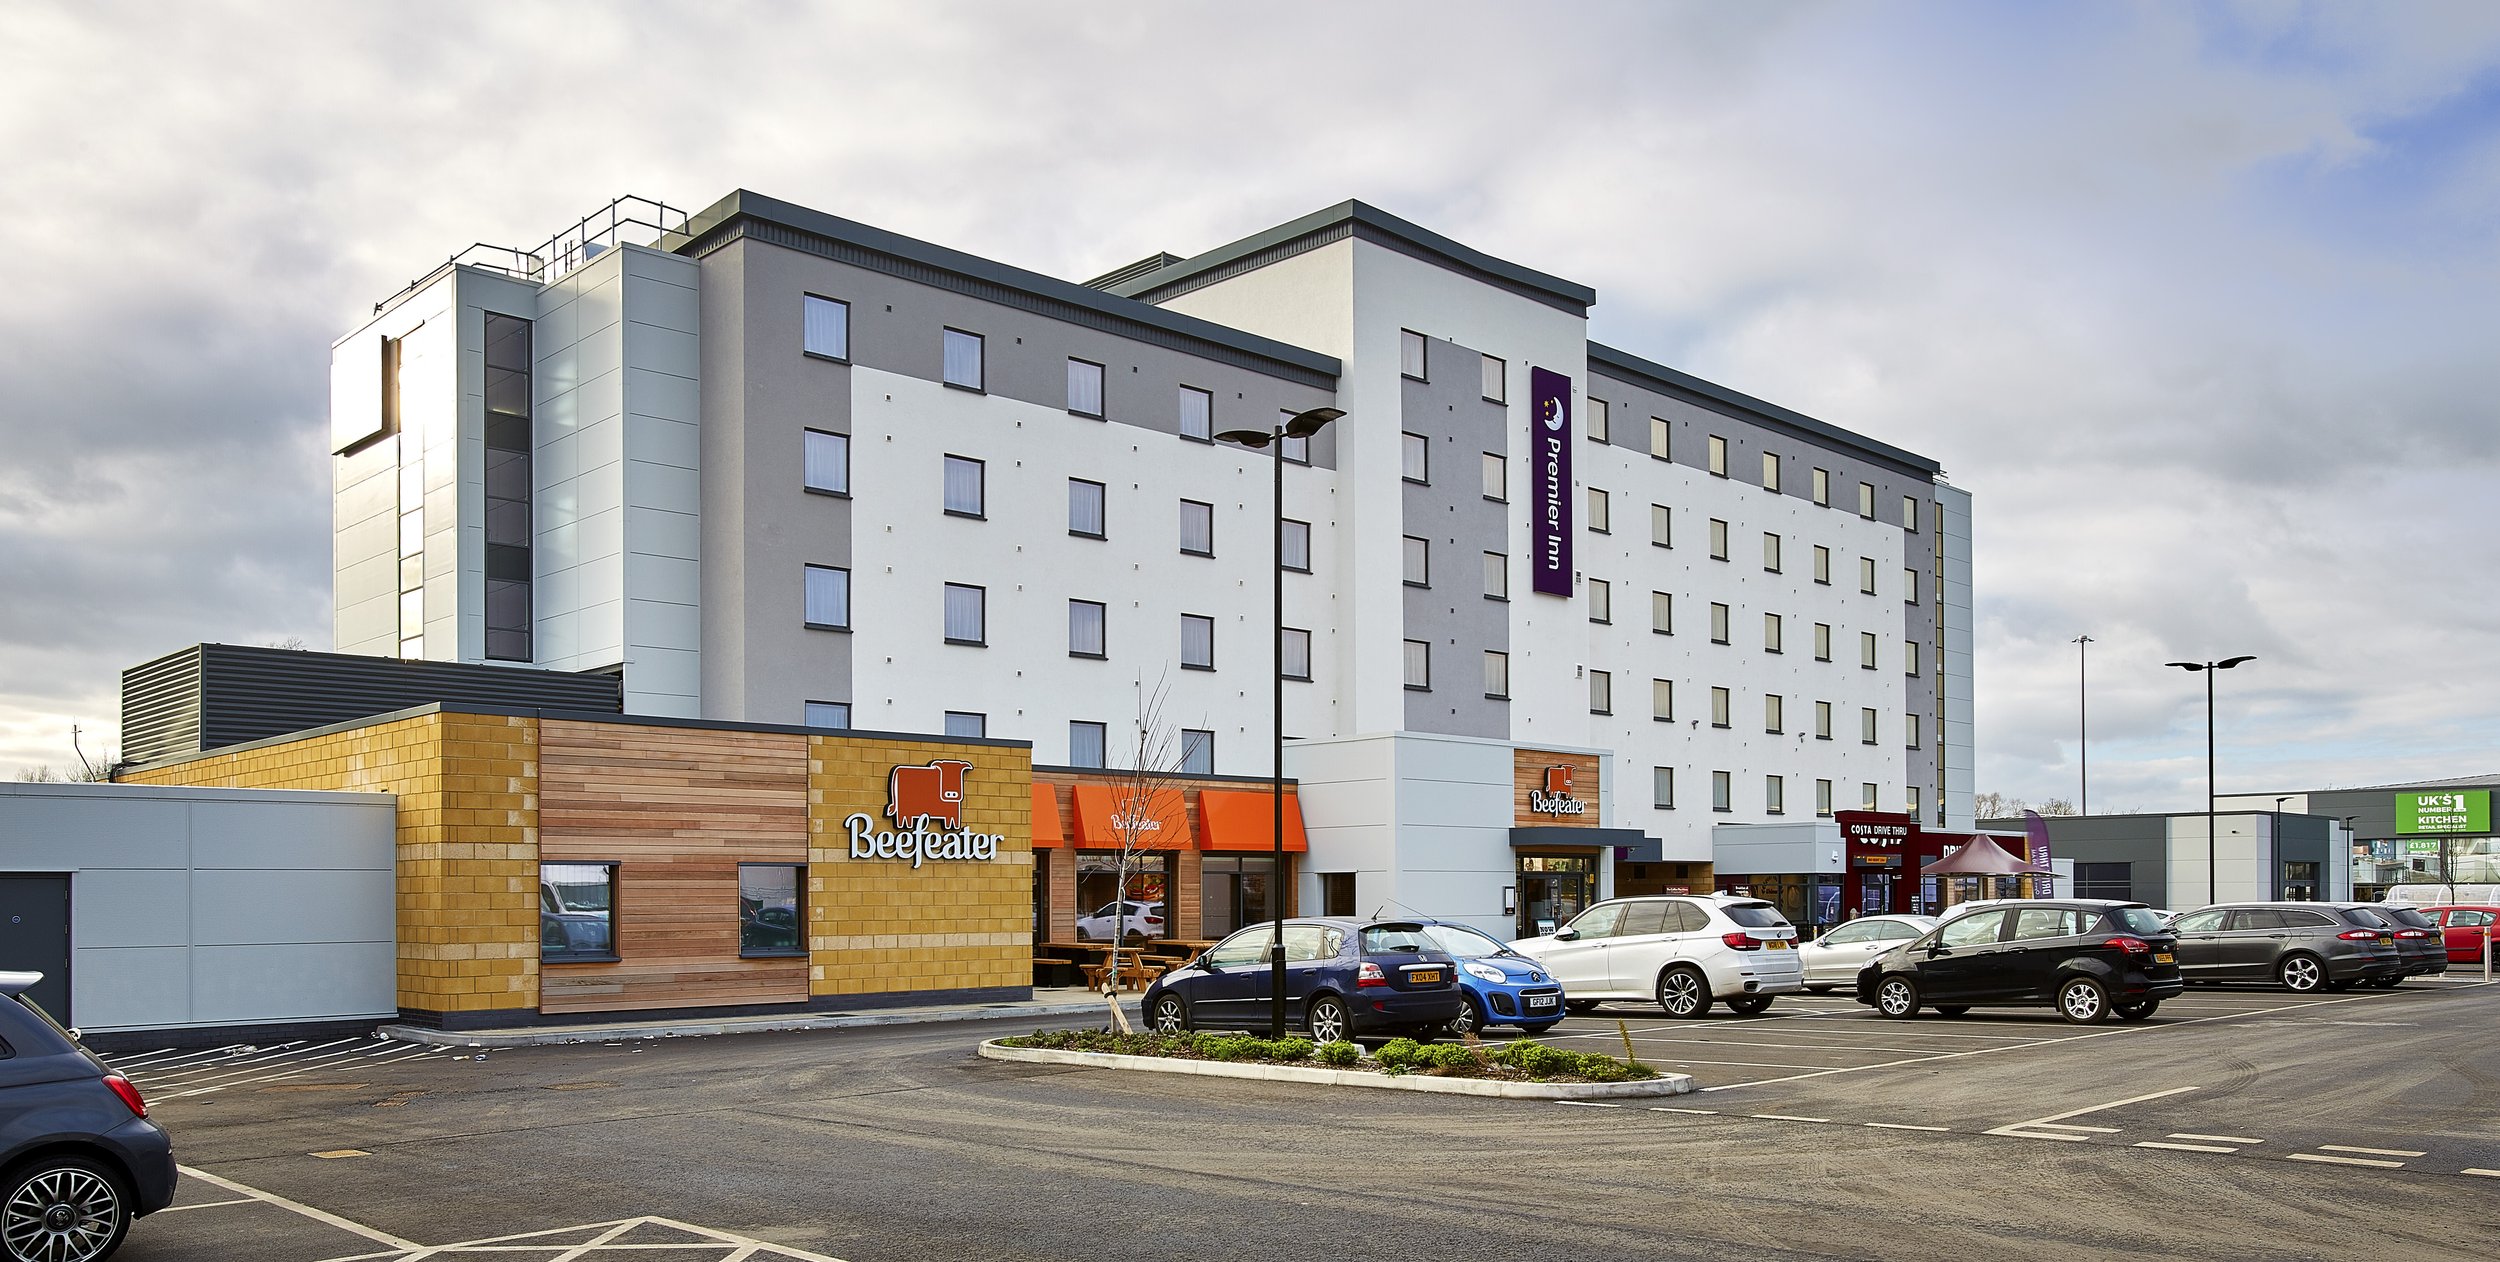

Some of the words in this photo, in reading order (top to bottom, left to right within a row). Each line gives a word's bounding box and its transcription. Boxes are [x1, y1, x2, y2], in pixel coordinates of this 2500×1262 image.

[1547, 437, 1562, 531] Premier
[1548, 534, 1562, 571] Inn
[1531, 790, 1588, 818] Beefeater
[2417, 806, 2452, 814] NUMBER
[1850, 824, 1872, 836] COSTA
[1873, 825, 1891, 835] DRIVE
[1892, 826, 1908, 836] THRU
[2417, 815, 2467, 824] KITCHEN
[844, 812, 1005, 869] Beefeater
